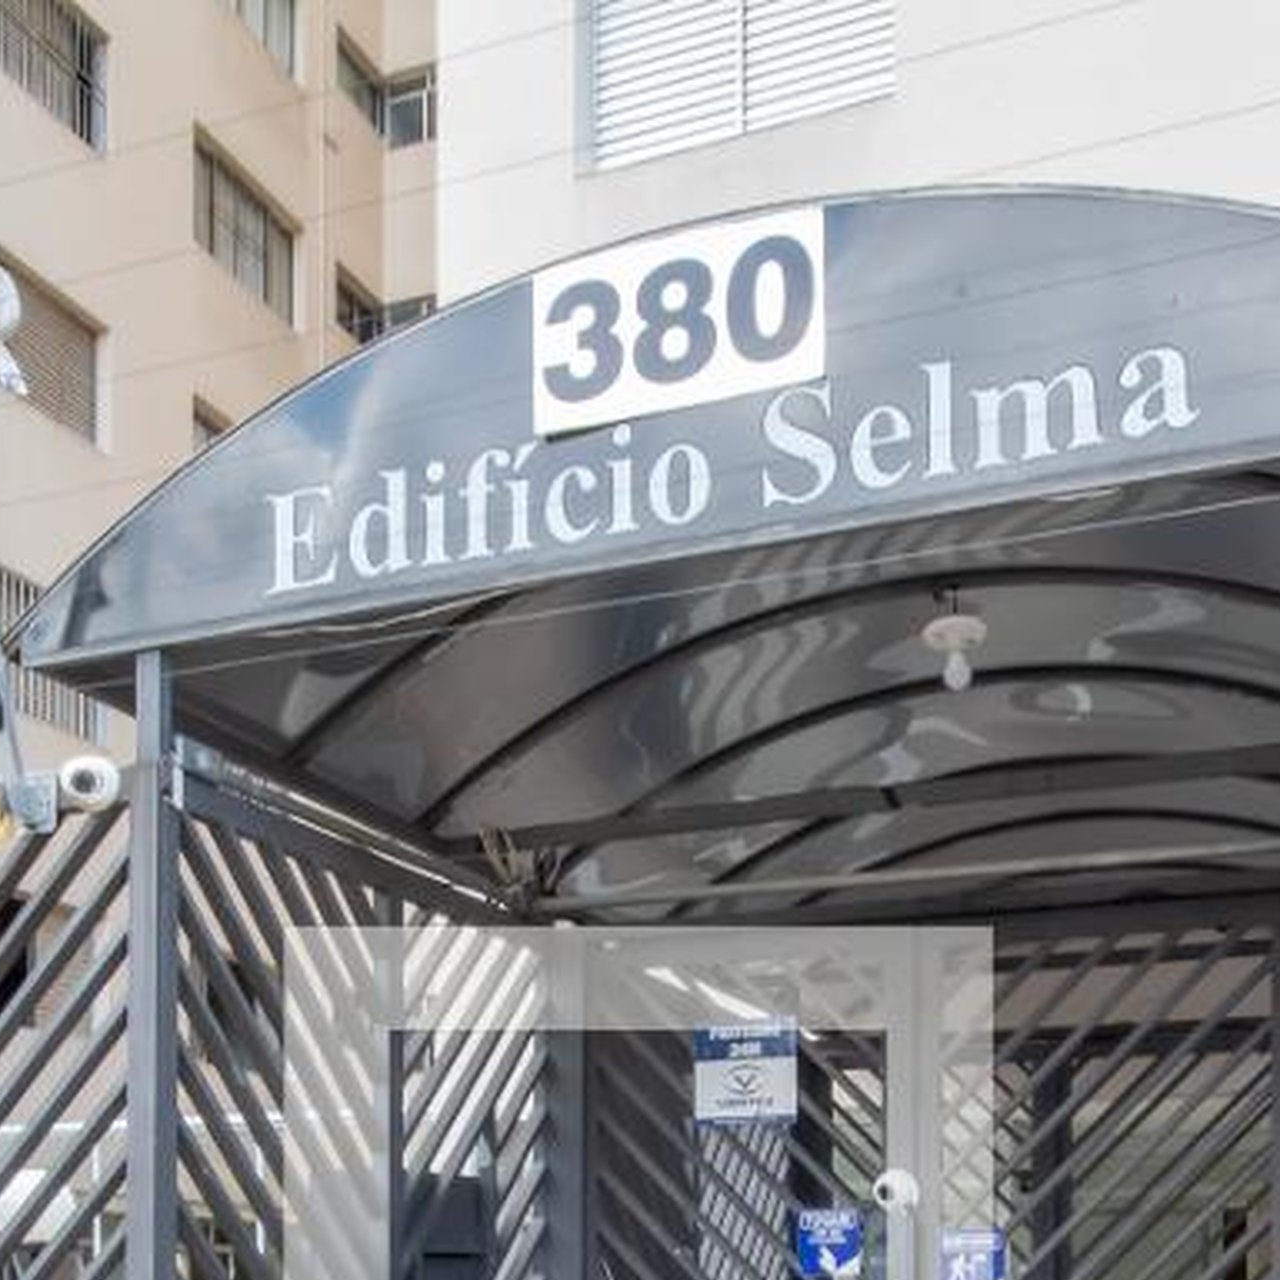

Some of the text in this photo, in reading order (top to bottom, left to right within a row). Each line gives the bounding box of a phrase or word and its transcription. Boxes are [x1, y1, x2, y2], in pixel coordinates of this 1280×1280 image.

[542, 234, 815, 403] 380
[264, 343, 1200, 595] Edifício Selma
